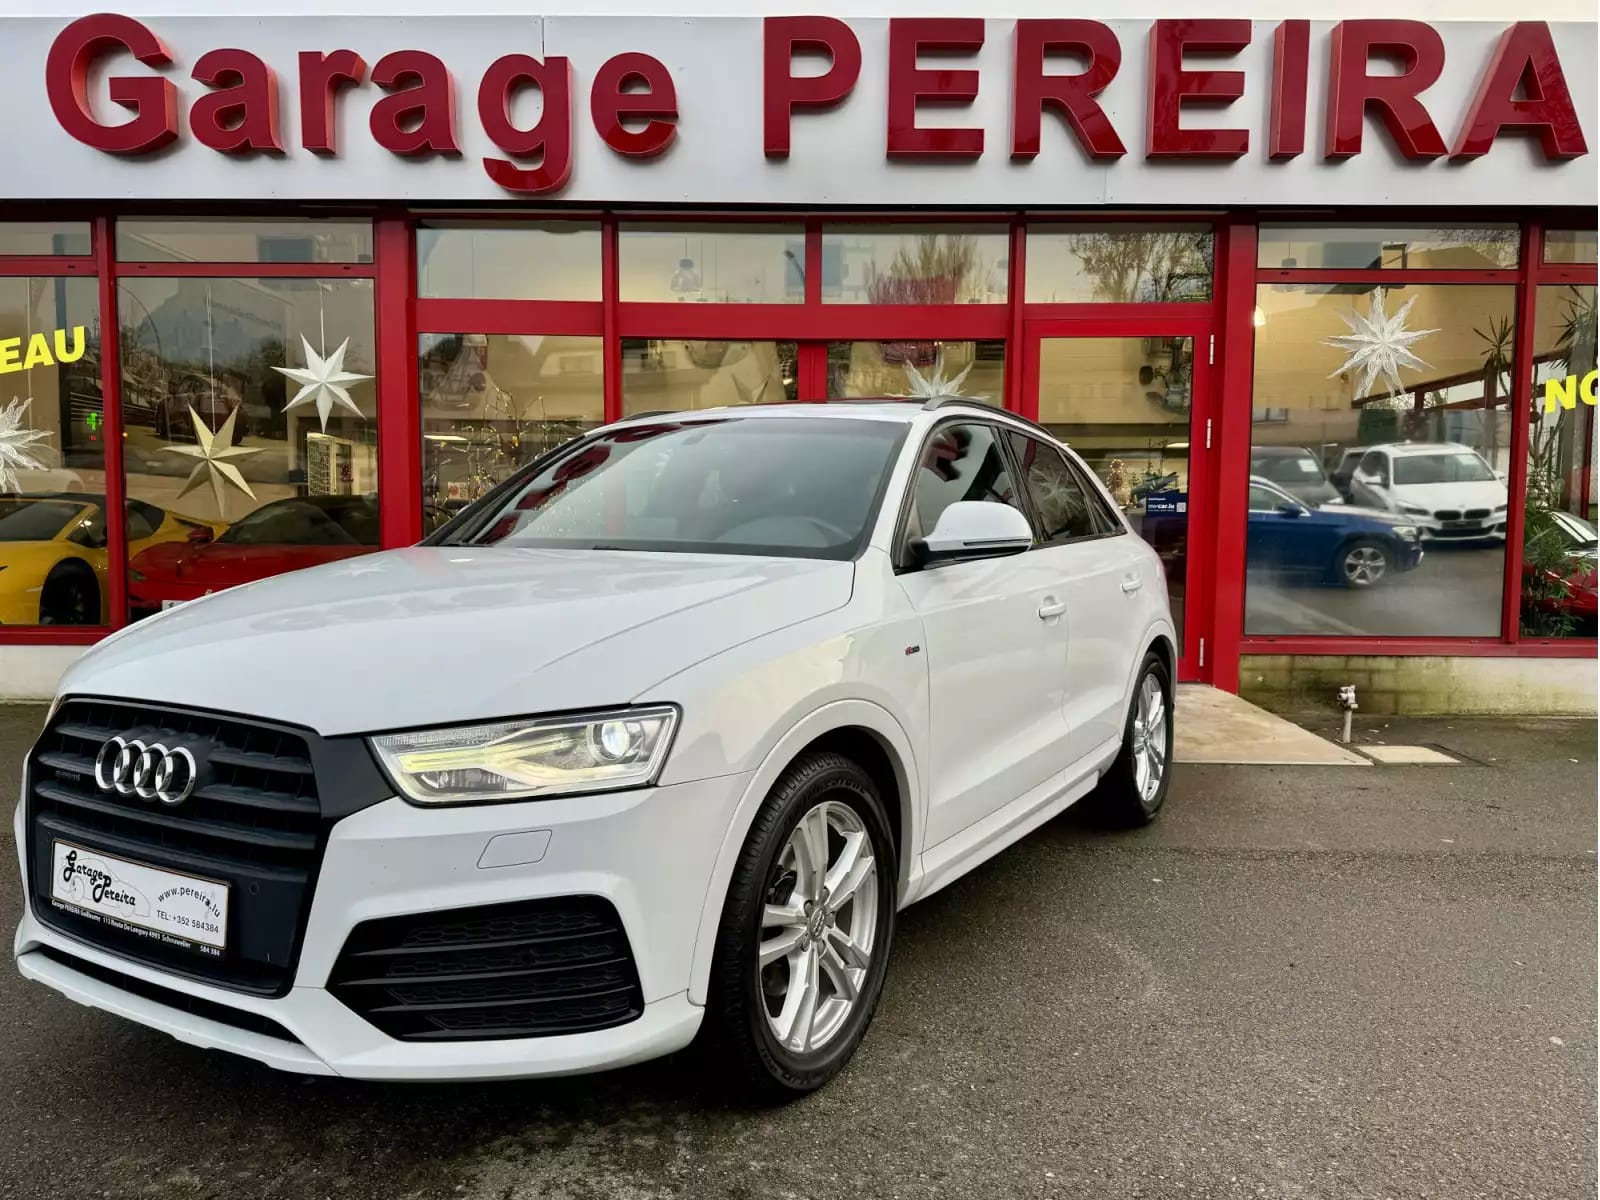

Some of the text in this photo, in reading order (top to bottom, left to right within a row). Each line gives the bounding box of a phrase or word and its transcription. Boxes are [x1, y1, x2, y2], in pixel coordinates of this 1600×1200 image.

[45, 13, 1589, 194] Garage PEREIRA
[0, 326, 86, 374] EAU
[63, 850, 104, 882] Garage
[92, 875, 136, 903] Pereira
[157, 886, 221, 918] www.pereira.lu
[156, 909, 219, 934] TEL: +352 584384
